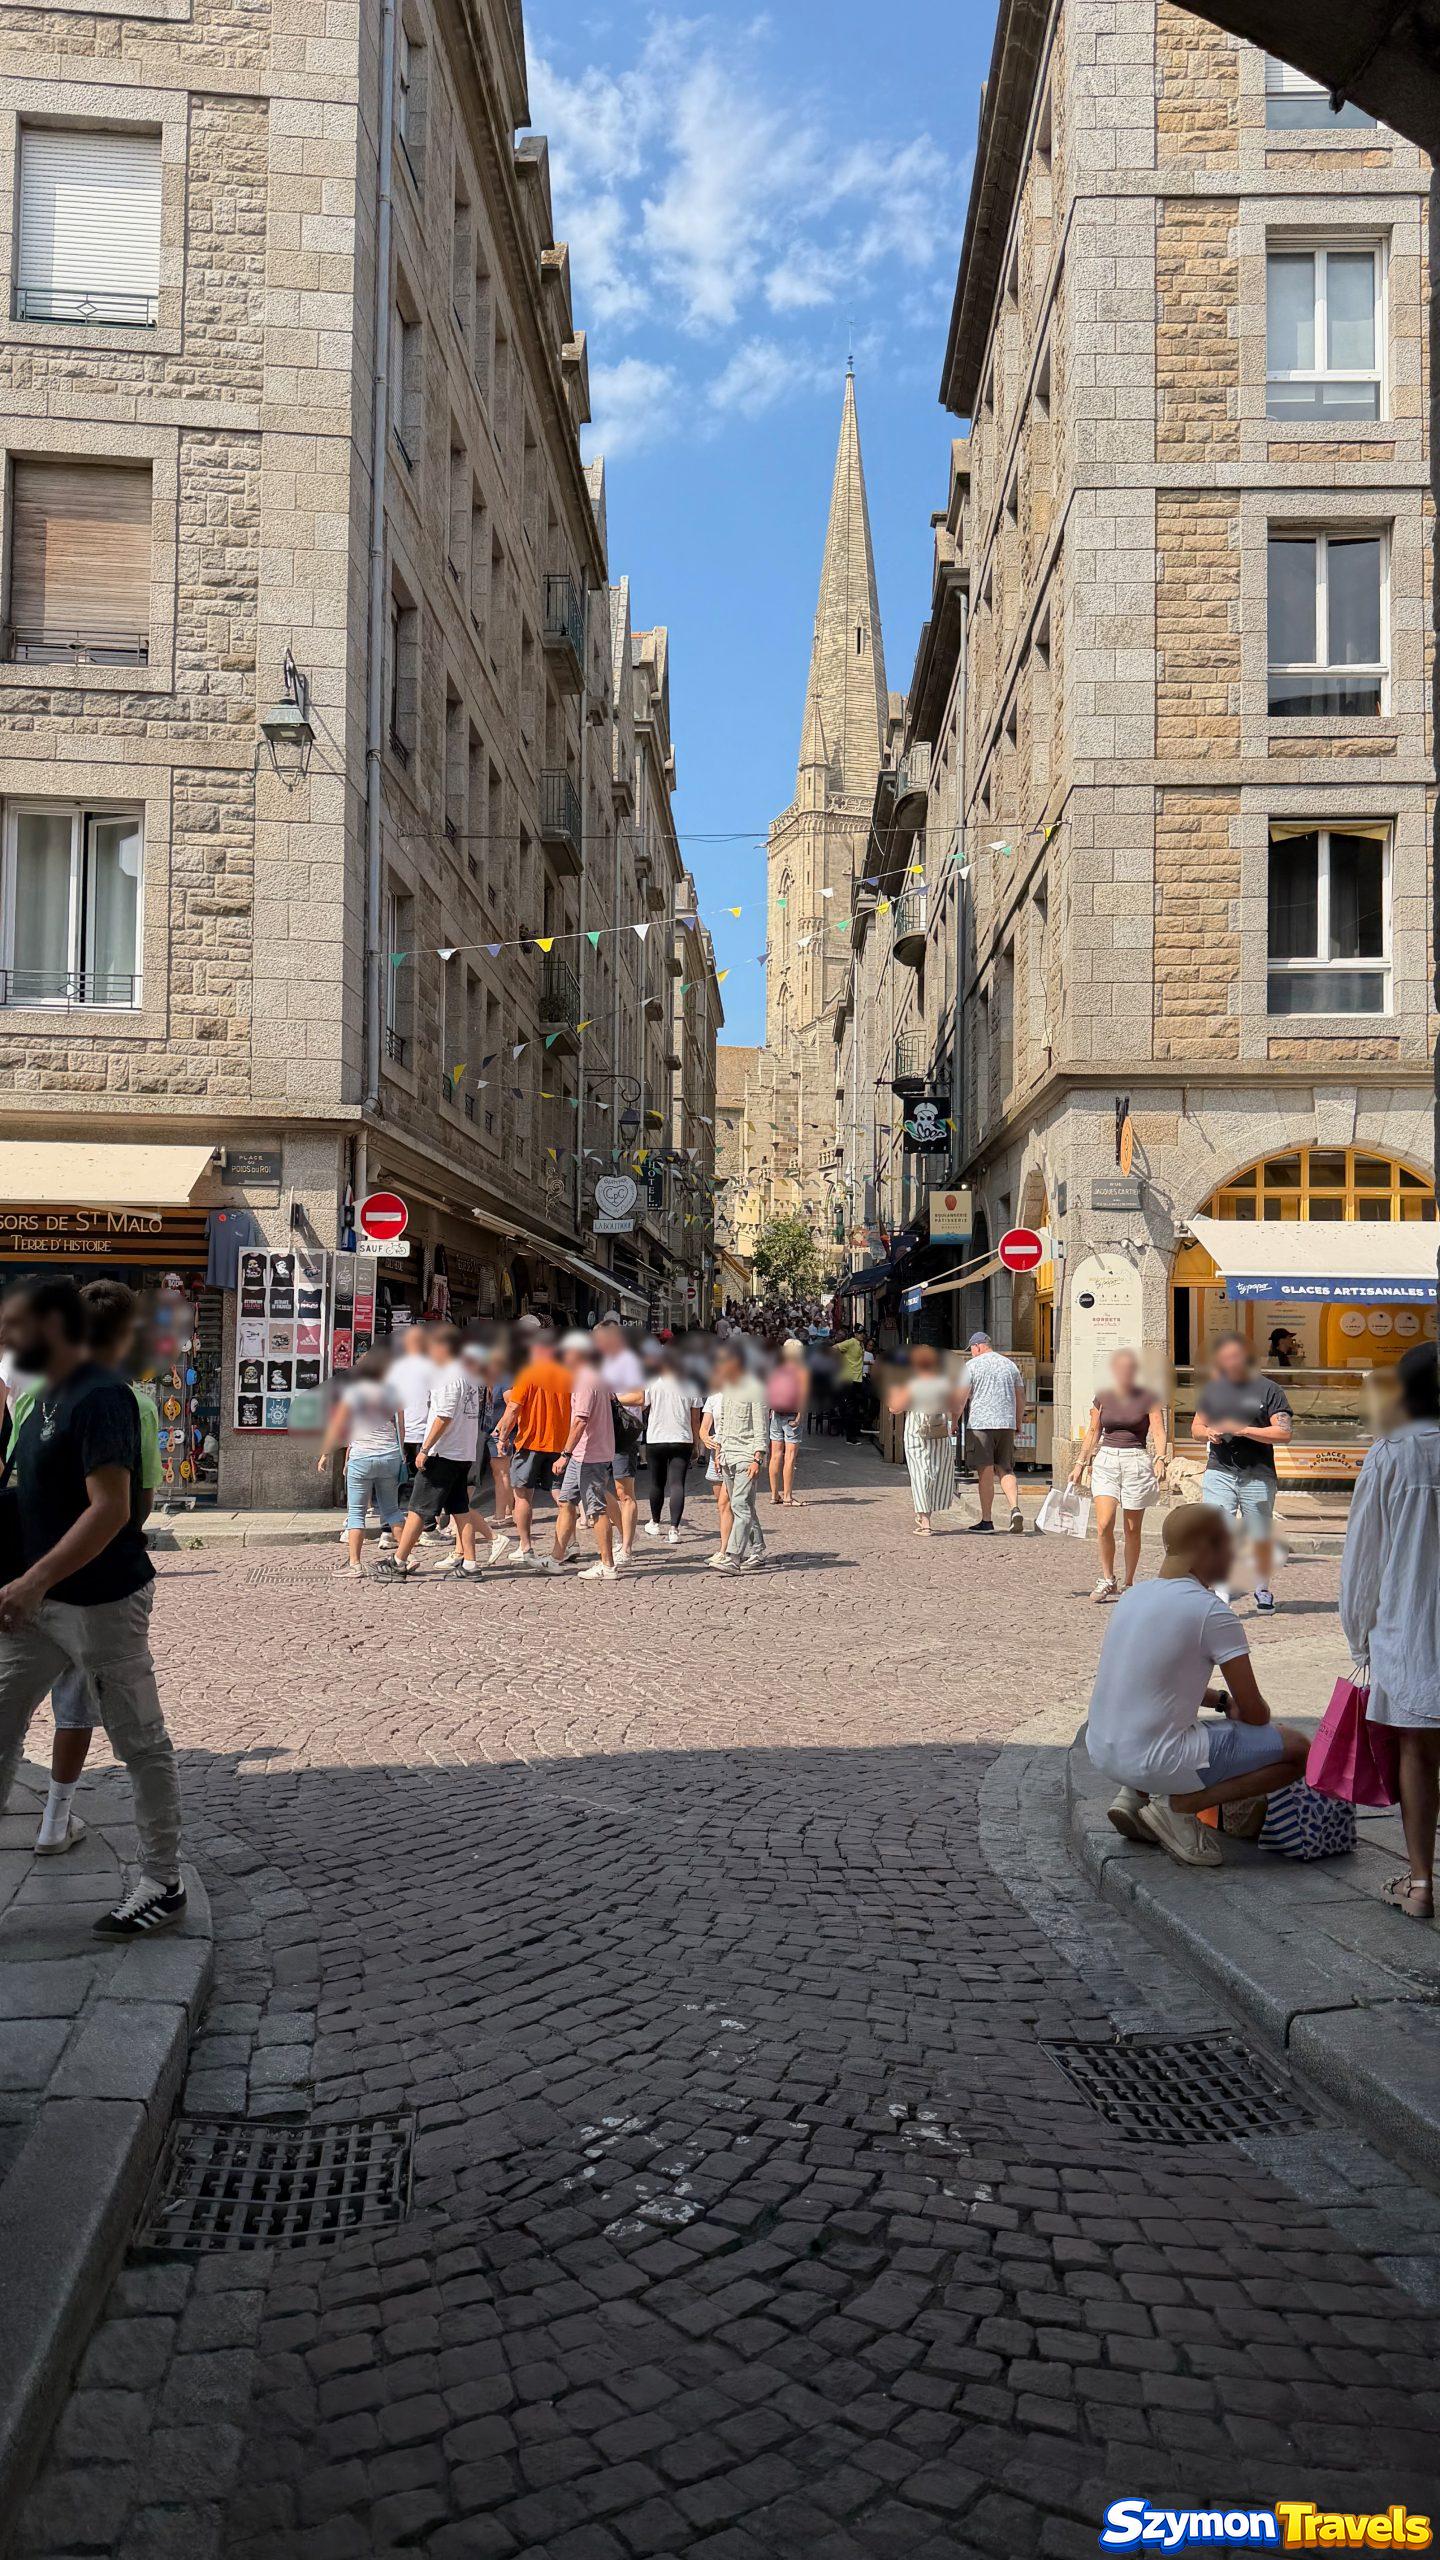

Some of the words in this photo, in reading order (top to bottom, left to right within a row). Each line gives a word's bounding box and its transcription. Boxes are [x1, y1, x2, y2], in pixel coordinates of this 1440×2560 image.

[231, 1165, 251, 1173] POIDS
[46, 1216, 69, 1231] DE
[107, 1213, 163, 1233] MALO
[11, 1234, 48, 1251] TERRE
[63, 1239, 112, 1252] HISTOIRE
[359, 1244, 383, 1253] SAUF
[1281, 1286, 1330, 1295] GLACES
[1334, 1287, 1425, 1297] ARTISANALES
[1315, 1451, 1346, 1460] GLACES
[1309, 1457, 1352, 1470] ARTISANALES
